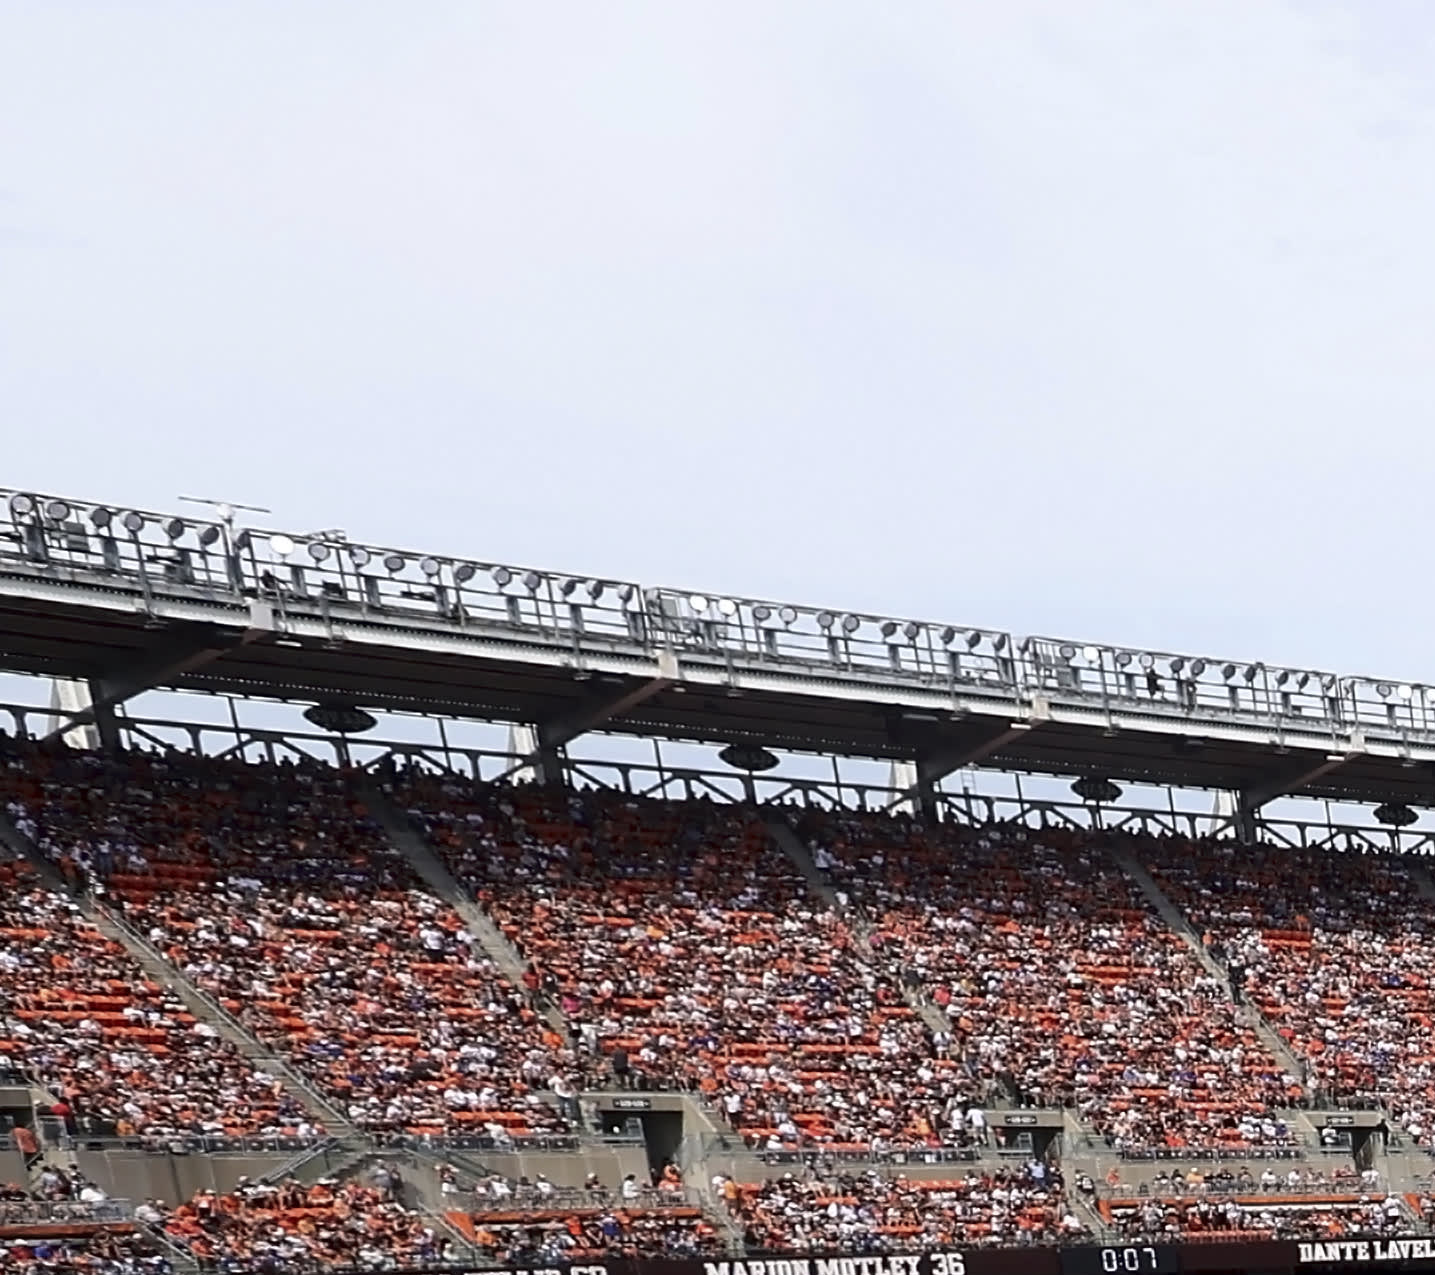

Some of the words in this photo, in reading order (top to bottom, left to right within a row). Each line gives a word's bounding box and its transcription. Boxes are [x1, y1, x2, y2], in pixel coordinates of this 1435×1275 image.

[1101, 1248, 1158, 1272] 0:07
[1299, 1242, 1370, 1263] DANTE
[930, 1253, 965, 1275] 36
